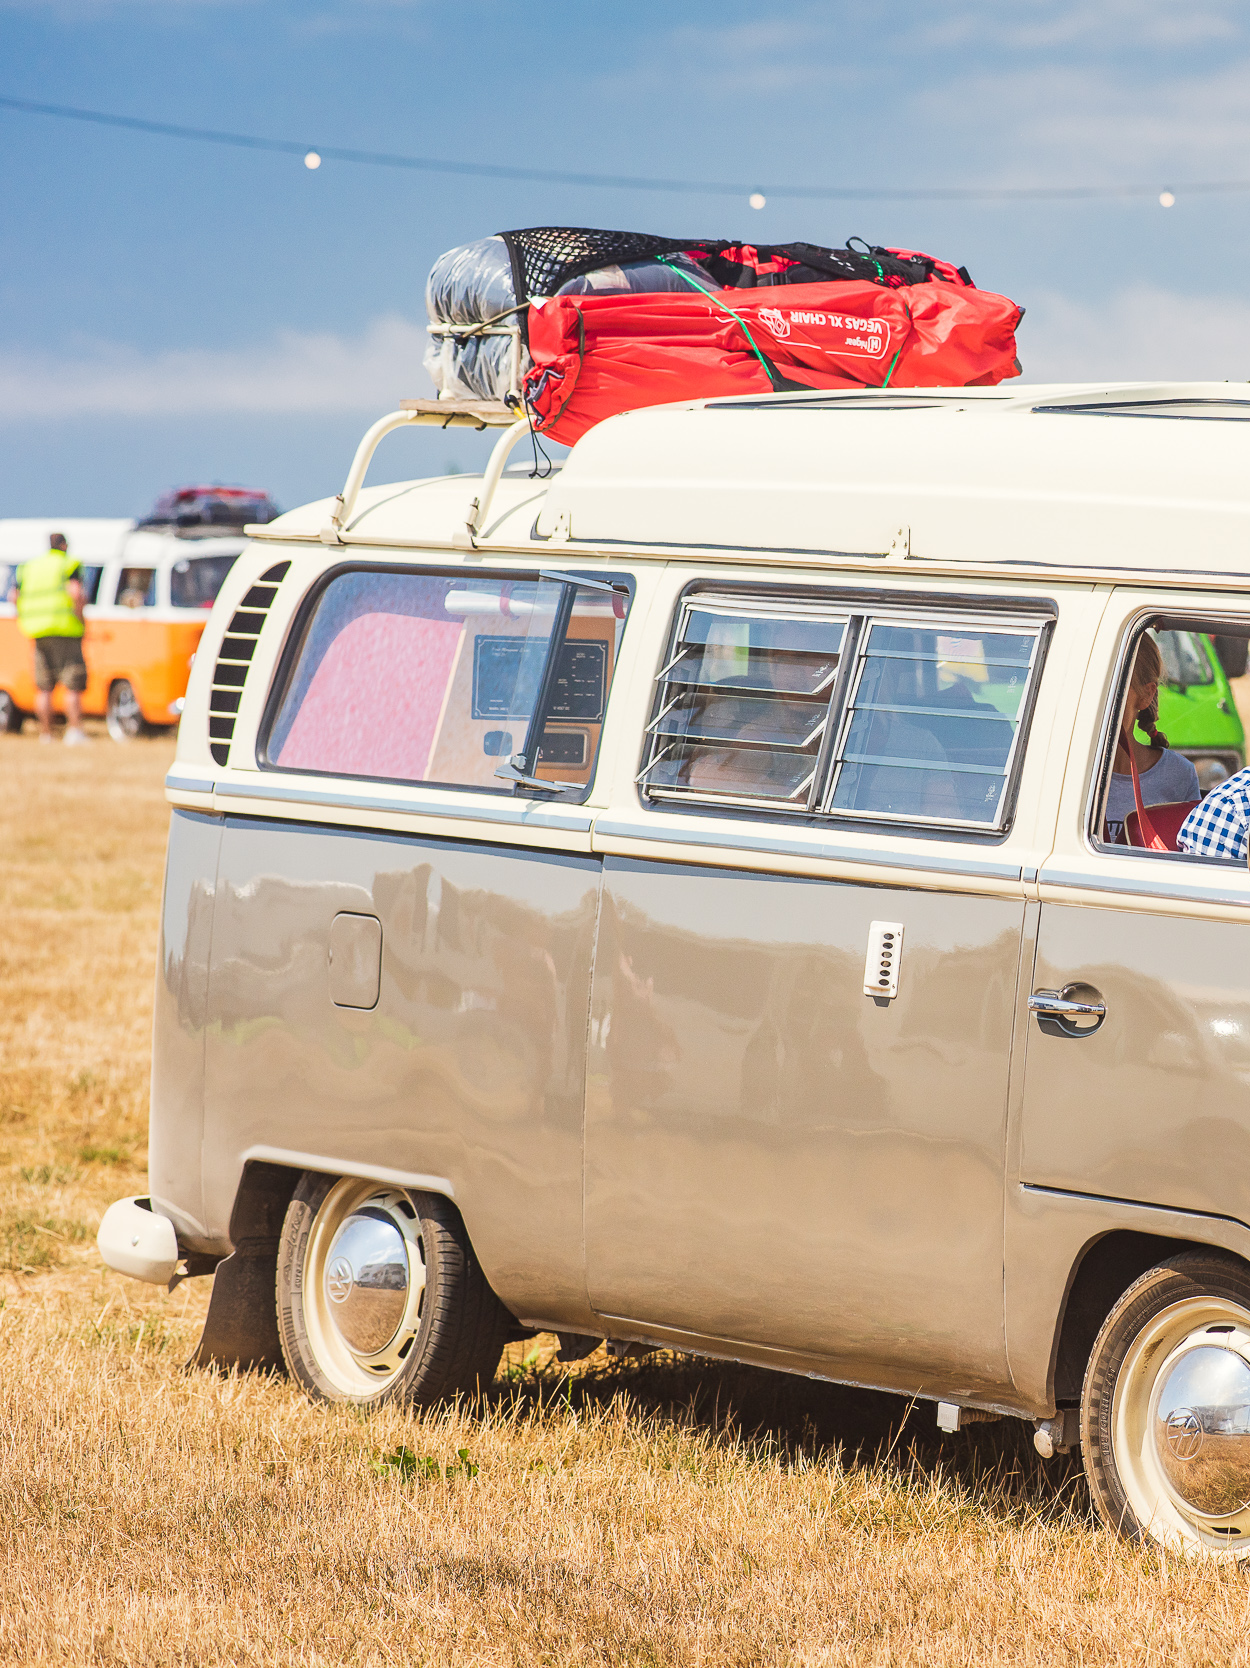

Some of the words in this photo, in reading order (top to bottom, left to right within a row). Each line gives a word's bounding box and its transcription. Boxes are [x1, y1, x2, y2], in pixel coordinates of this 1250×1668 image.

[790, 310, 826, 326] CHAIR
[828, 315, 843, 328] XL
[845, 318, 882, 334] VEGAS
[845, 337, 869, 350] higear
